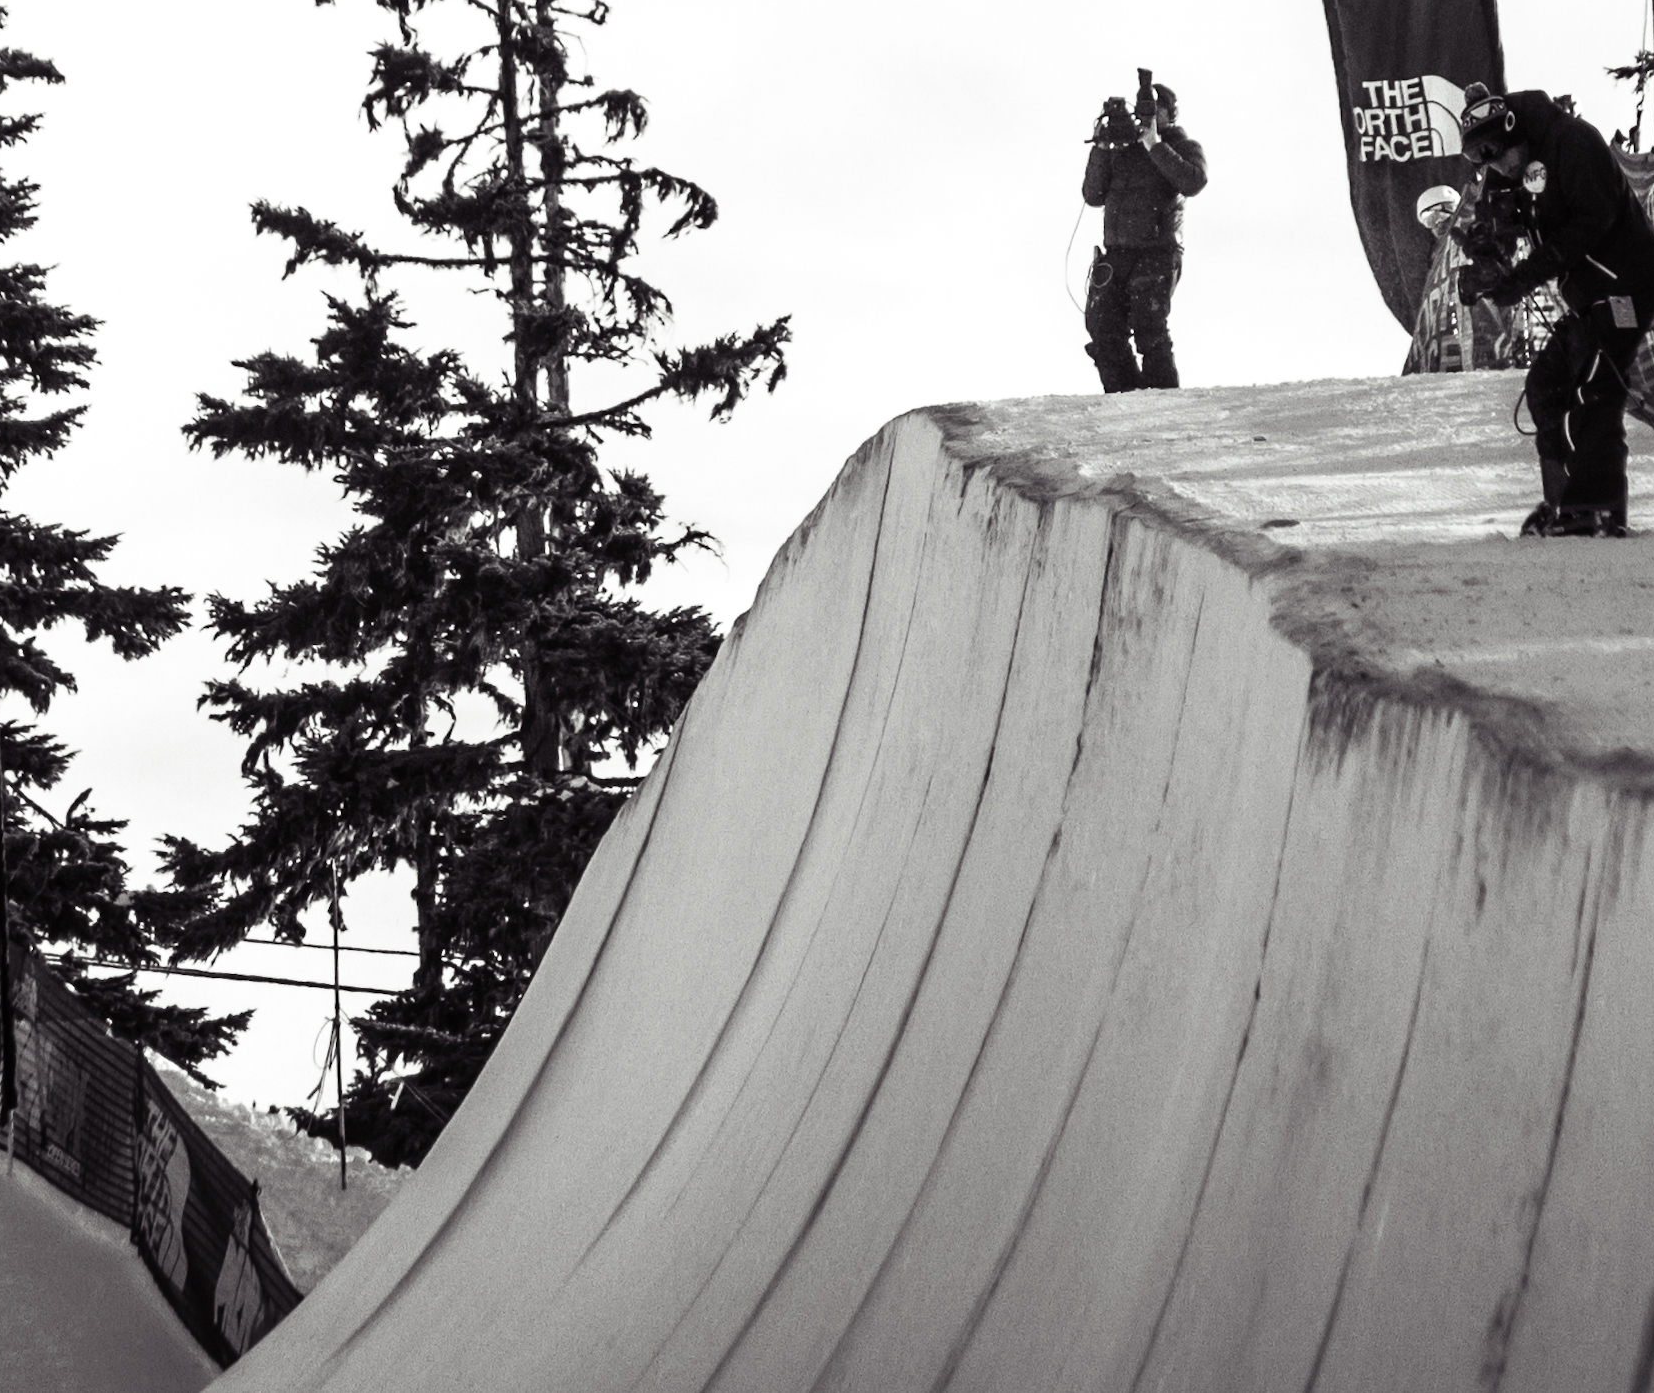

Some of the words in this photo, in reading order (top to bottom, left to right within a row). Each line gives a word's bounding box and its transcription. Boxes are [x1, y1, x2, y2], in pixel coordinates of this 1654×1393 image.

[1362, 77, 1424, 108] THE
[1353, 103, 1428, 136] ORTH
[1360, 130, 1433, 163] FACE
